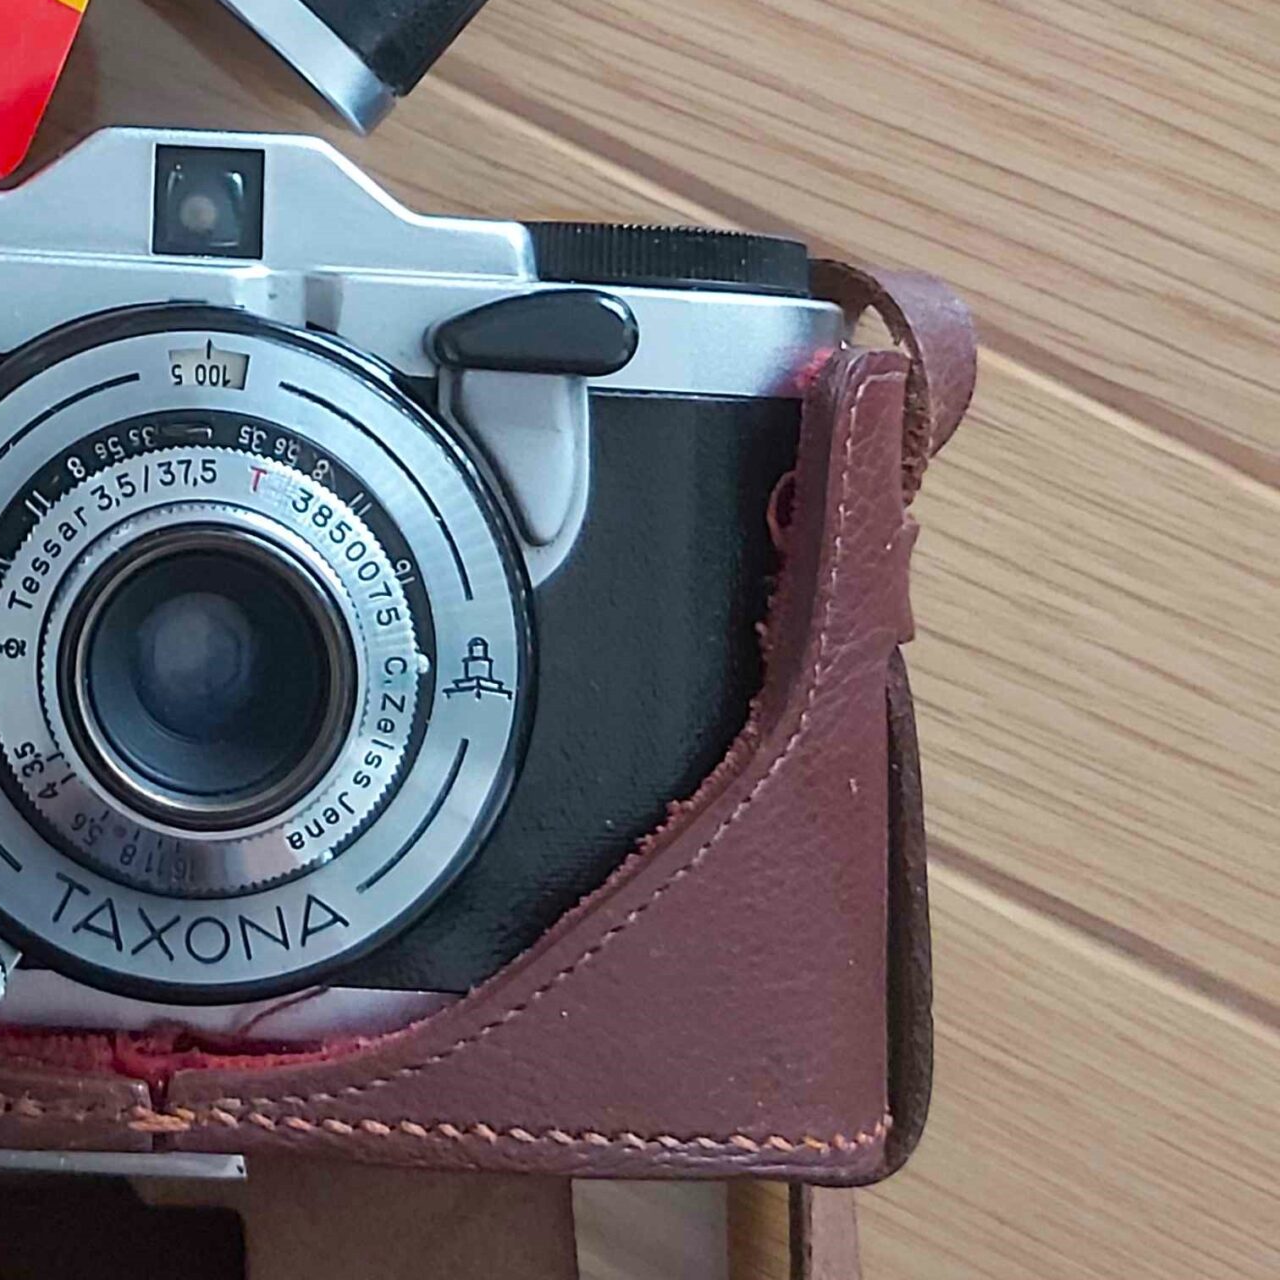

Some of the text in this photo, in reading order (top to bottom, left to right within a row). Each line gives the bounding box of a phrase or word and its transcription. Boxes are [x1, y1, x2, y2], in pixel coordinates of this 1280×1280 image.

[194, 362, 231, 387] 100
[67, 456, 87, 479] 8
[250, 465, 268, 493] T
[311, 458, 330, 481] 8
[8, 505, 88, 610] Tessar
[292, 488, 401, 624] 3850075
[37, 781, 59, 800] 4
[286, 791, 356, 851] Jena
[120, 843, 137, 866] 8
[52, 871, 351, 965] TAXONA
